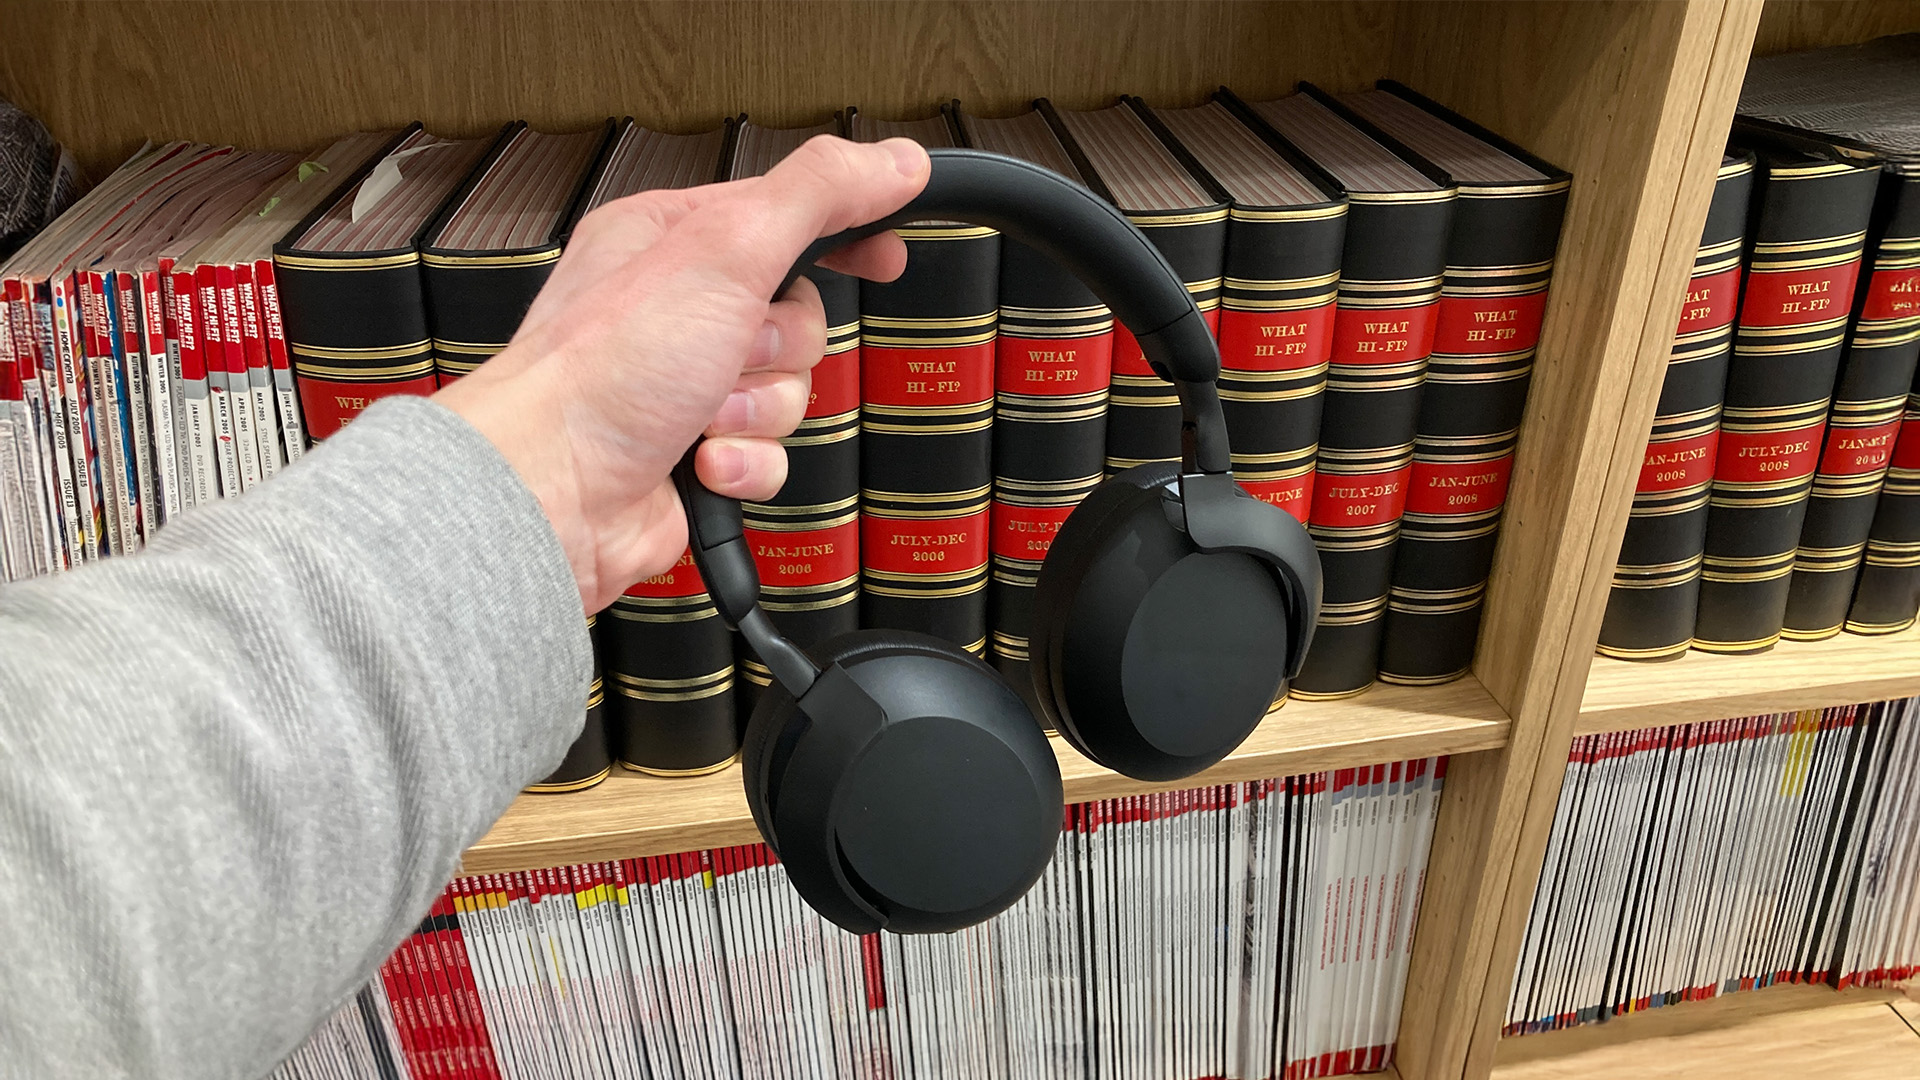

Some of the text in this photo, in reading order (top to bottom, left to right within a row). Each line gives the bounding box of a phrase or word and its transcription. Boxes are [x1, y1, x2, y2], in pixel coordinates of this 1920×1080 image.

[243, 282, 254, 311] WHAT
[1684, 289, 1710, 303] HAT
[1787, 281, 1830, 295] WHAT
[95, 293, 105, 316] WHAT
[125, 289, 134, 312] WHAT
[151, 290, 160, 313] WHAT
[205, 286, 217, 314] WHAT
[225, 287, 237, 316] WHAT
[266, 284, 277, 312] WHAT
[180, 293, 193, 322] WHAT
[1474, 310, 1518, 323] WHAT
[1260, 324, 1307, 337] WHAT
[1364, 321, 1409, 334] WHAT
[1028, 351, 1076, 363] WHAT
[91, 360, 100, 385] SUMMER
[104, 359, 112, 384] AUTUMN
[131, 355, 139, 379] AUTUMN
[908, 362, 956, 373] WHAT
[94, 385, 102, 400] 2005
[106, 385, 114, 398] 2005
[176, 386, 184, 407] PLASMA
[282, 393, 291, 407] JUNE
[69, 398, 78, 416] JULY
[219, 396, 227, 417] MARCH
[55, 412, 63, 429] MAY
[157, 357, 165, 379] WINTER
[162, 400, 170, 420] PLASMA
[167, 469, 175, 489] PLAYERS
[240, 417, 248, 432] 2005
[286, 409, 294, 424] 2005
[73, 417, 81, 435] 2005
[221, 419, 229, 434] 2005
[57, 431, 66, 449] 2005
[138, 435, 146, 444] LCD
[190, 403, 200, 431] JANUARY
[198, 468, 207, 499] RECORDERS
[262, 444, 273, 469] SPEAKER
[1645, 447, 1706, 465] AN-JUNE
[1739, 440, 1810, 458] JULY-DEC
[77, 458, 86, 479] ISSUE
[142, 458, 151, 487] PROJECTORS
[182, 457, 190, 477] PLAYERS
[1759, 460, 1789, 472] 2008
[1429, 473, 1498, 487] JAN-JUNE
[1656, 469, 1686, 482] 2008
[63, 478, 73, 500] ISSUE
[184, 481, 192, 500] DIGITAL
[1252, 487, 1302, 503] N-JUNE
[1328, 482, 1399, 499] JULY-DEC
[1448, 494, 1478, 505] 2008
[121, 501, 129, 523] SYSTEMS
[146, 505, 154, 524] PLAYERS
[1346, 504, 1376, 516] 2007
[1008, 520, 1062, 532] JULY-D
[123, 527, 132, 547] TUNERS
[891, 532, 967, 546] JULY-DEC
[1027, 540, 1051, 550] 200
[758, 543, 834, 557] JAN-JUNE
[913, 551, 945, 562] 2006
[779, 564, 812, 574] 2006
[641, 574, 674, 584] 006
